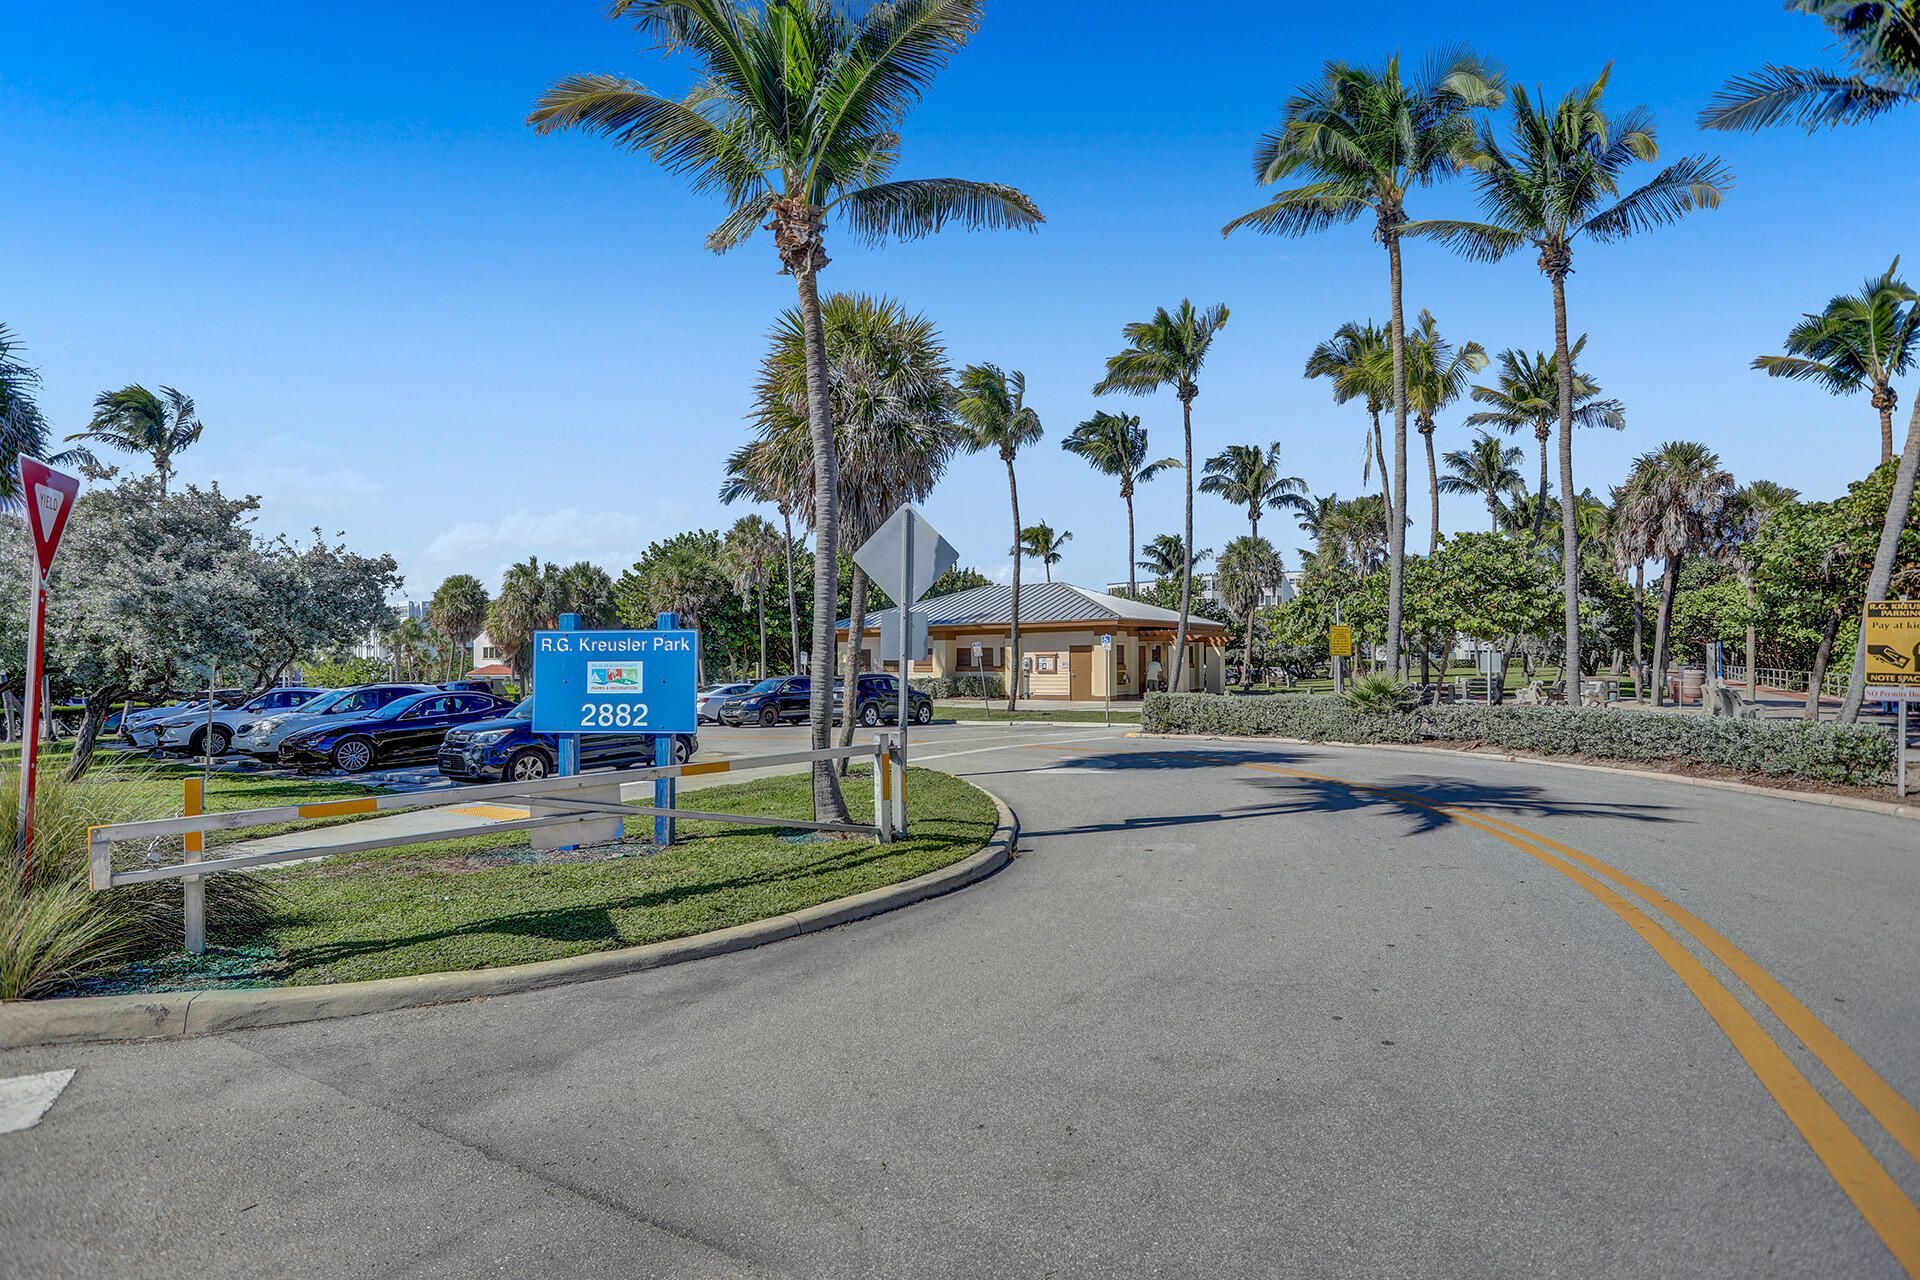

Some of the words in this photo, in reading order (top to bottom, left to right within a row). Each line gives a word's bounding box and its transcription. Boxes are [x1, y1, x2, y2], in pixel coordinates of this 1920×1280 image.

[39, 493, 58, 511] YIELD
[1872, 622, 1889, 631] Pay
[541, 638, 573, 652] R.G.
[579, 637, 647, 652] Kreusler
[653, 637, 690, 651] Park
[1870, 674, 1896, 682] NOTE
[580, 703, 649, 727] 2882
